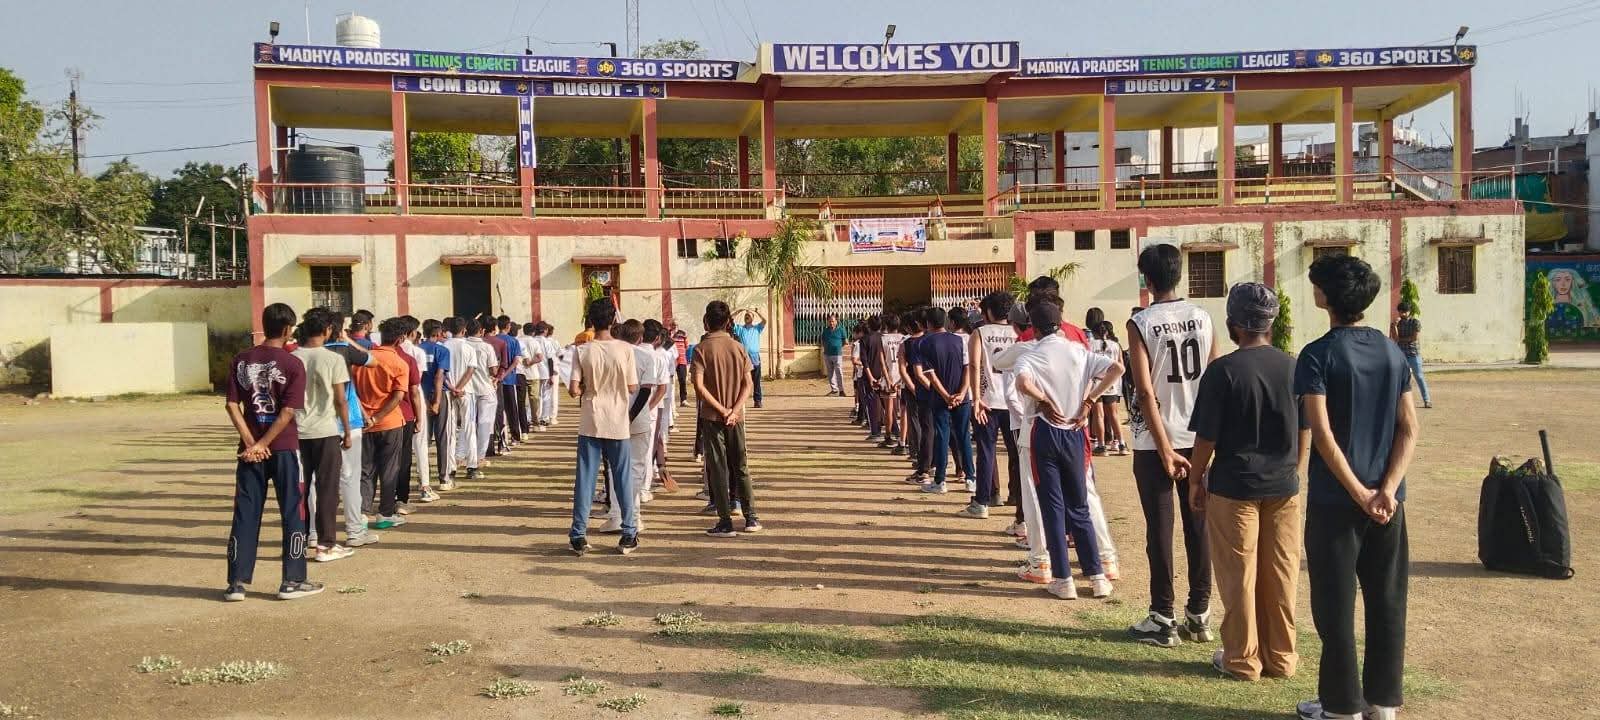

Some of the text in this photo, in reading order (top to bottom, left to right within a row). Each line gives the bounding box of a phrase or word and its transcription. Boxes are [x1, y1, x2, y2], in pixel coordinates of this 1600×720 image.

[279, 47, 571, 73] MADHYA PRADESH TENNIS CRICKET LEAGUE
[783, 43, 1011, 71] WELCOMES YOU
[1026, 53, 1290, 75] MADHYA PRADESH TENNIS CRICKET LEAGUE
[1339, 48, 1452, 66] 360 SPORTS
[620, 61, 734, 78] 360 SPORTS
[465, 79, 502, 94] BOX
[553, 82, 622, 97] DUGOUT
[635, 84, 644, 97] 1
[1124, 78, 1192, 93] DUGOUT
[1205, 78, 1216, 91] 2
[1166, 338, 1201, 384] 10
